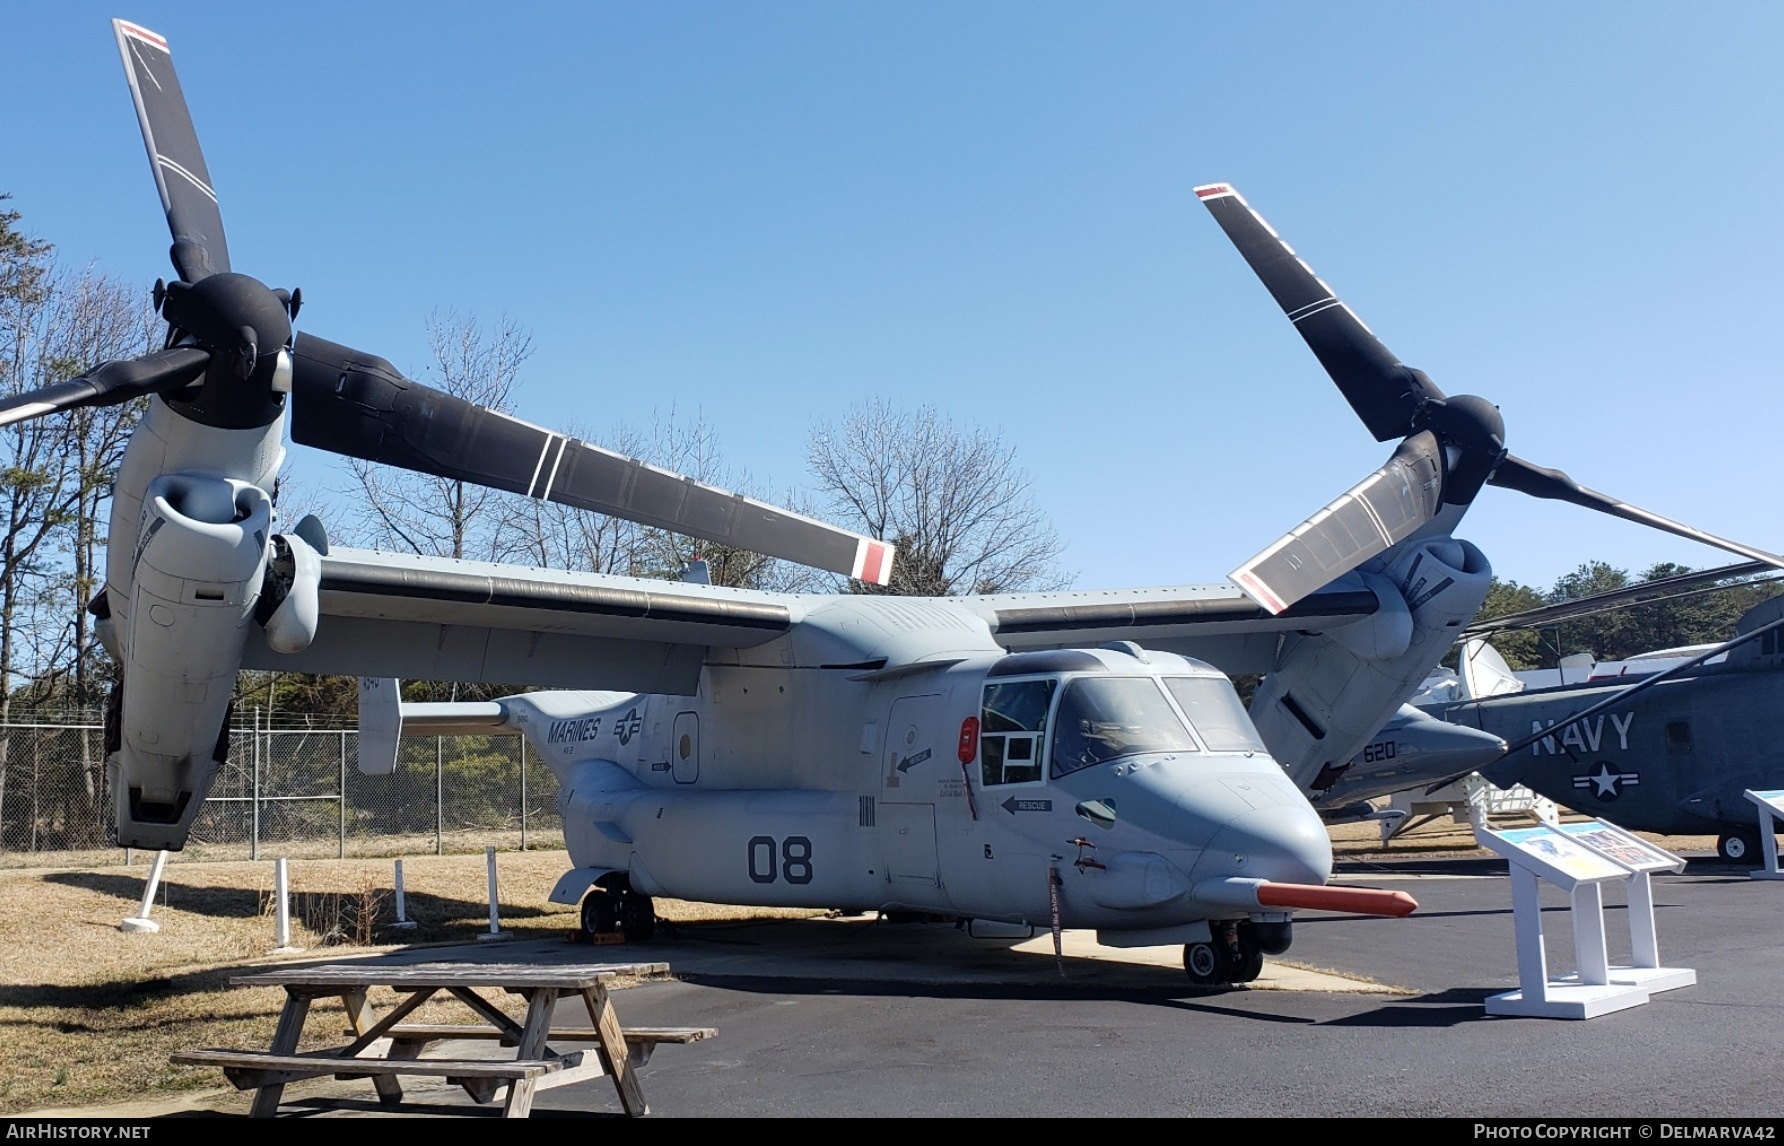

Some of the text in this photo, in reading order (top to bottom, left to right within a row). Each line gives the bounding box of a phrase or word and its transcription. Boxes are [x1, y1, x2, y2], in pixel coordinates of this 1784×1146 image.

[547, 717, 602, 744] MARINES
[1532, 711, 1635, 756] NAVY
[1363, 741, 1396, 764] 620
[1018, 801, 1046, 810] RESCUE
[748, 836, 813, 885] 08
[1050, 884, 1058, 912] REMOVE
